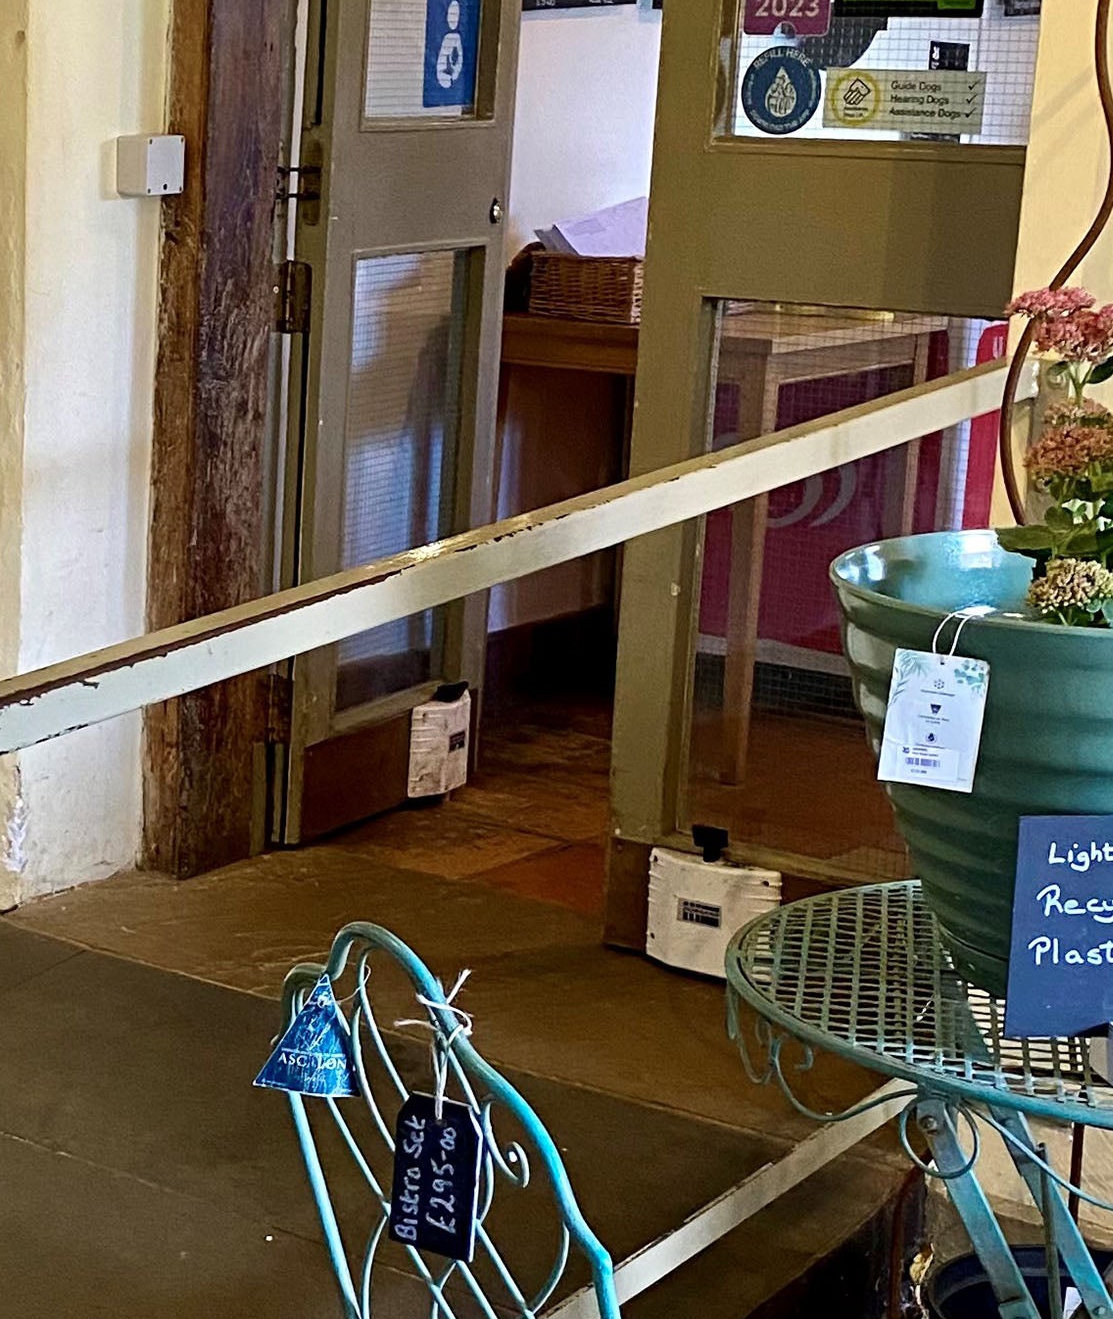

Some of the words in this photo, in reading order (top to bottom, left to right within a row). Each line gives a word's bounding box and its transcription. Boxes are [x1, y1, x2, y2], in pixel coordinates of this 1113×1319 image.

[890, 81, 917, 91] Guide
[919, 82, 942, 94] Dogs
[890, 94, 925, 105] Hearing
[926, 95, 950, 107] Dogs
[889, 107, 936, 118] Assistance
[938, 109, 961, 121] Dogs
[1047, 841, 1113, 872] Light
[1028, 935, 1113, 965] Plast
[278, 1052, 348, 1071] ASCLON
[402, 1114, 427, 1160] Set
[394, 1166, 422, 1242] Bistro
